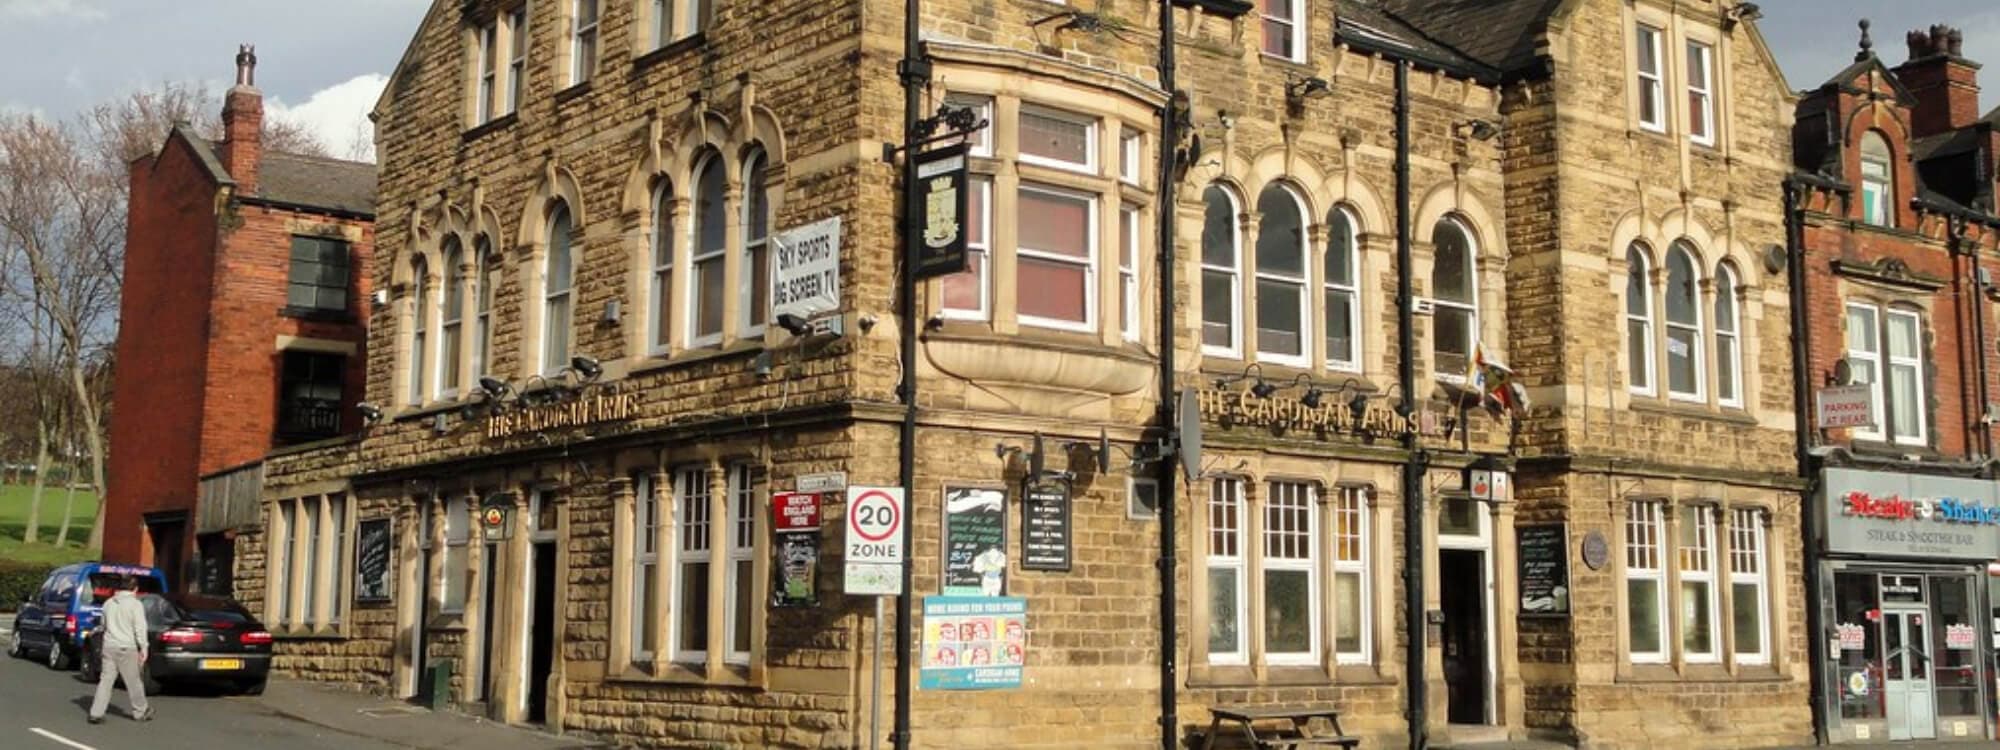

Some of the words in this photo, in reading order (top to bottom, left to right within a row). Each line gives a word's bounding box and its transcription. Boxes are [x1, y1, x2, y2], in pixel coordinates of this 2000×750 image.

[798, 235, 830, 264] SPORTS
[790, 272, 822, 303] SCREEN
[1824, 402, 1866, 411] PARKING
[1362, 402, 1419, 433] ARMS
[1827, 415, 1841, 424] AT
[1842, 414, 1866, 424] REAR
[784, 505, 816, 516] ENGLAND
[859, 505, 892, 526] 20
[1867, 529, 1897, 541] STEAK
[851, 544, 896, 557] ZONE
